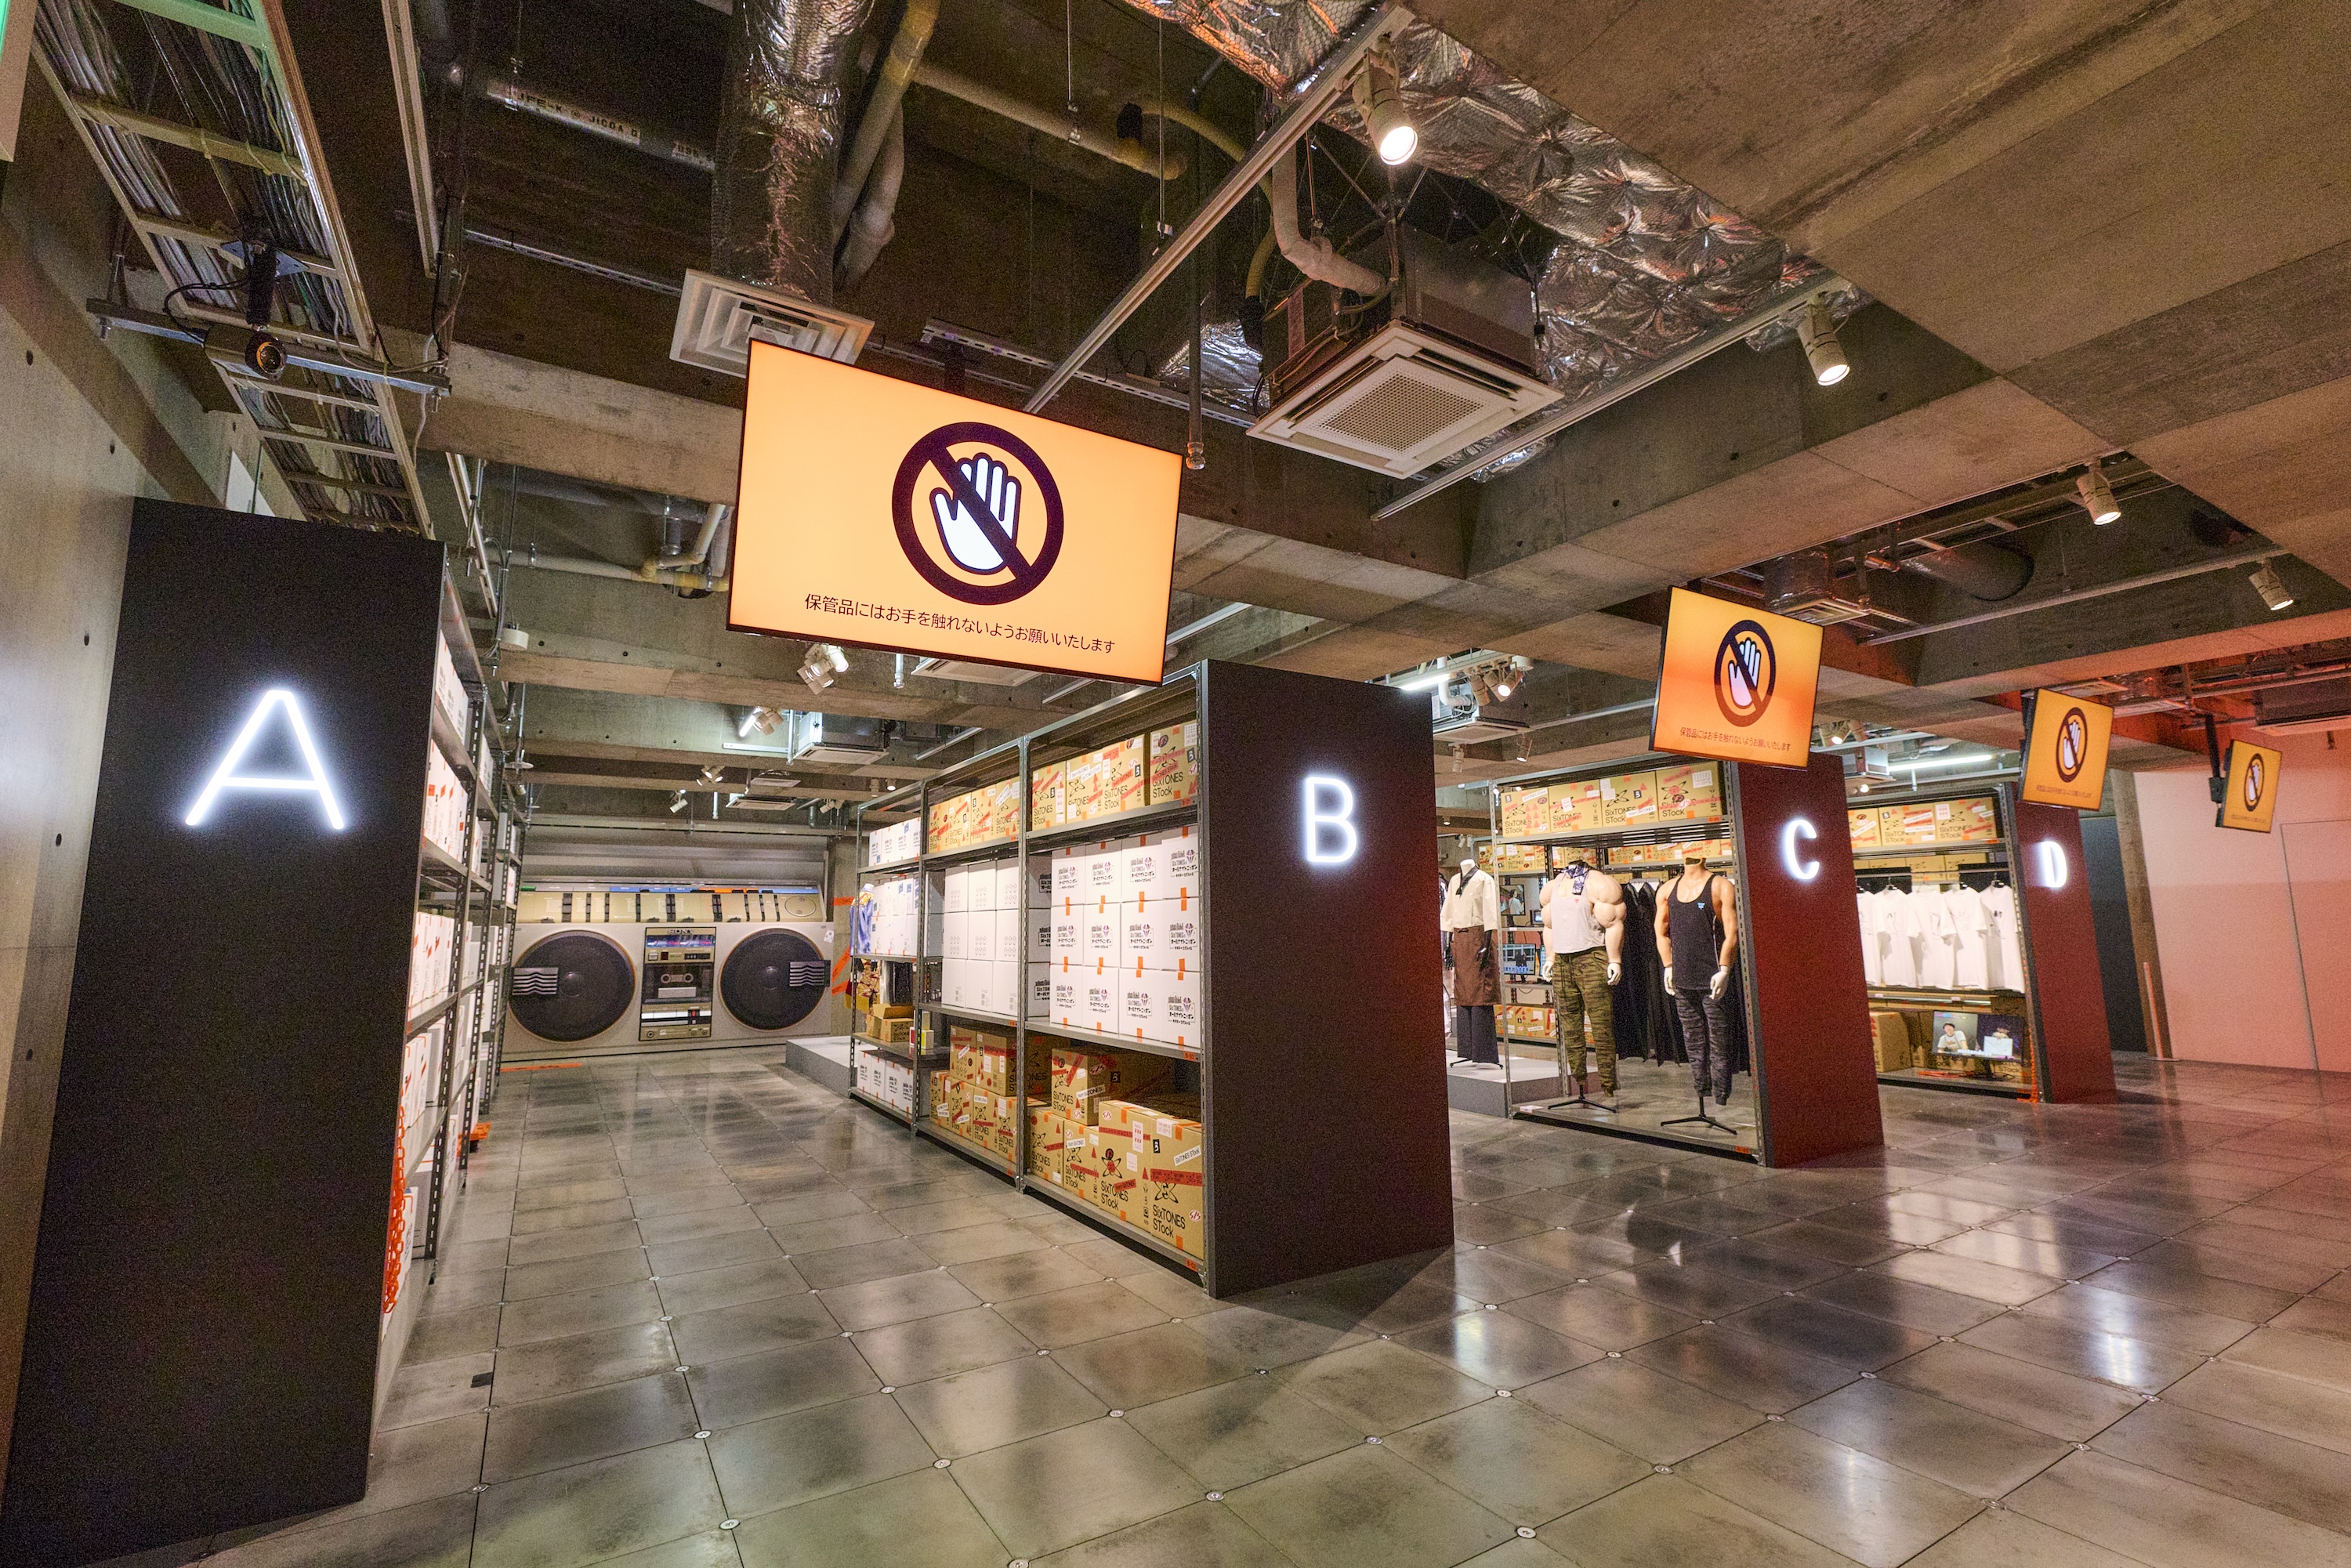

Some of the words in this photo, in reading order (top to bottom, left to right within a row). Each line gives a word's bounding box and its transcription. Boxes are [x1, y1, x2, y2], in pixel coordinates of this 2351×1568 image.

[805, 592, 1115, 654] 保管品にはお手を触れないようお願いいたします
[1680, 726, 1791, 751] 保管品にはお手を触れないようお願いいたします
[184, 688, 346, 830] A
[1153, 772, 1183, 787] SixTONES
[1153, 786, 1172, 798] STock
[1305, 774, 1358, 867] B
[1780, 819, 1820, 881] C
[2044, 841, 2069, 888] D
[1153, 1205, 1185, 1229] SixTONES
[1153, 1219, 1174, 1238] STock
